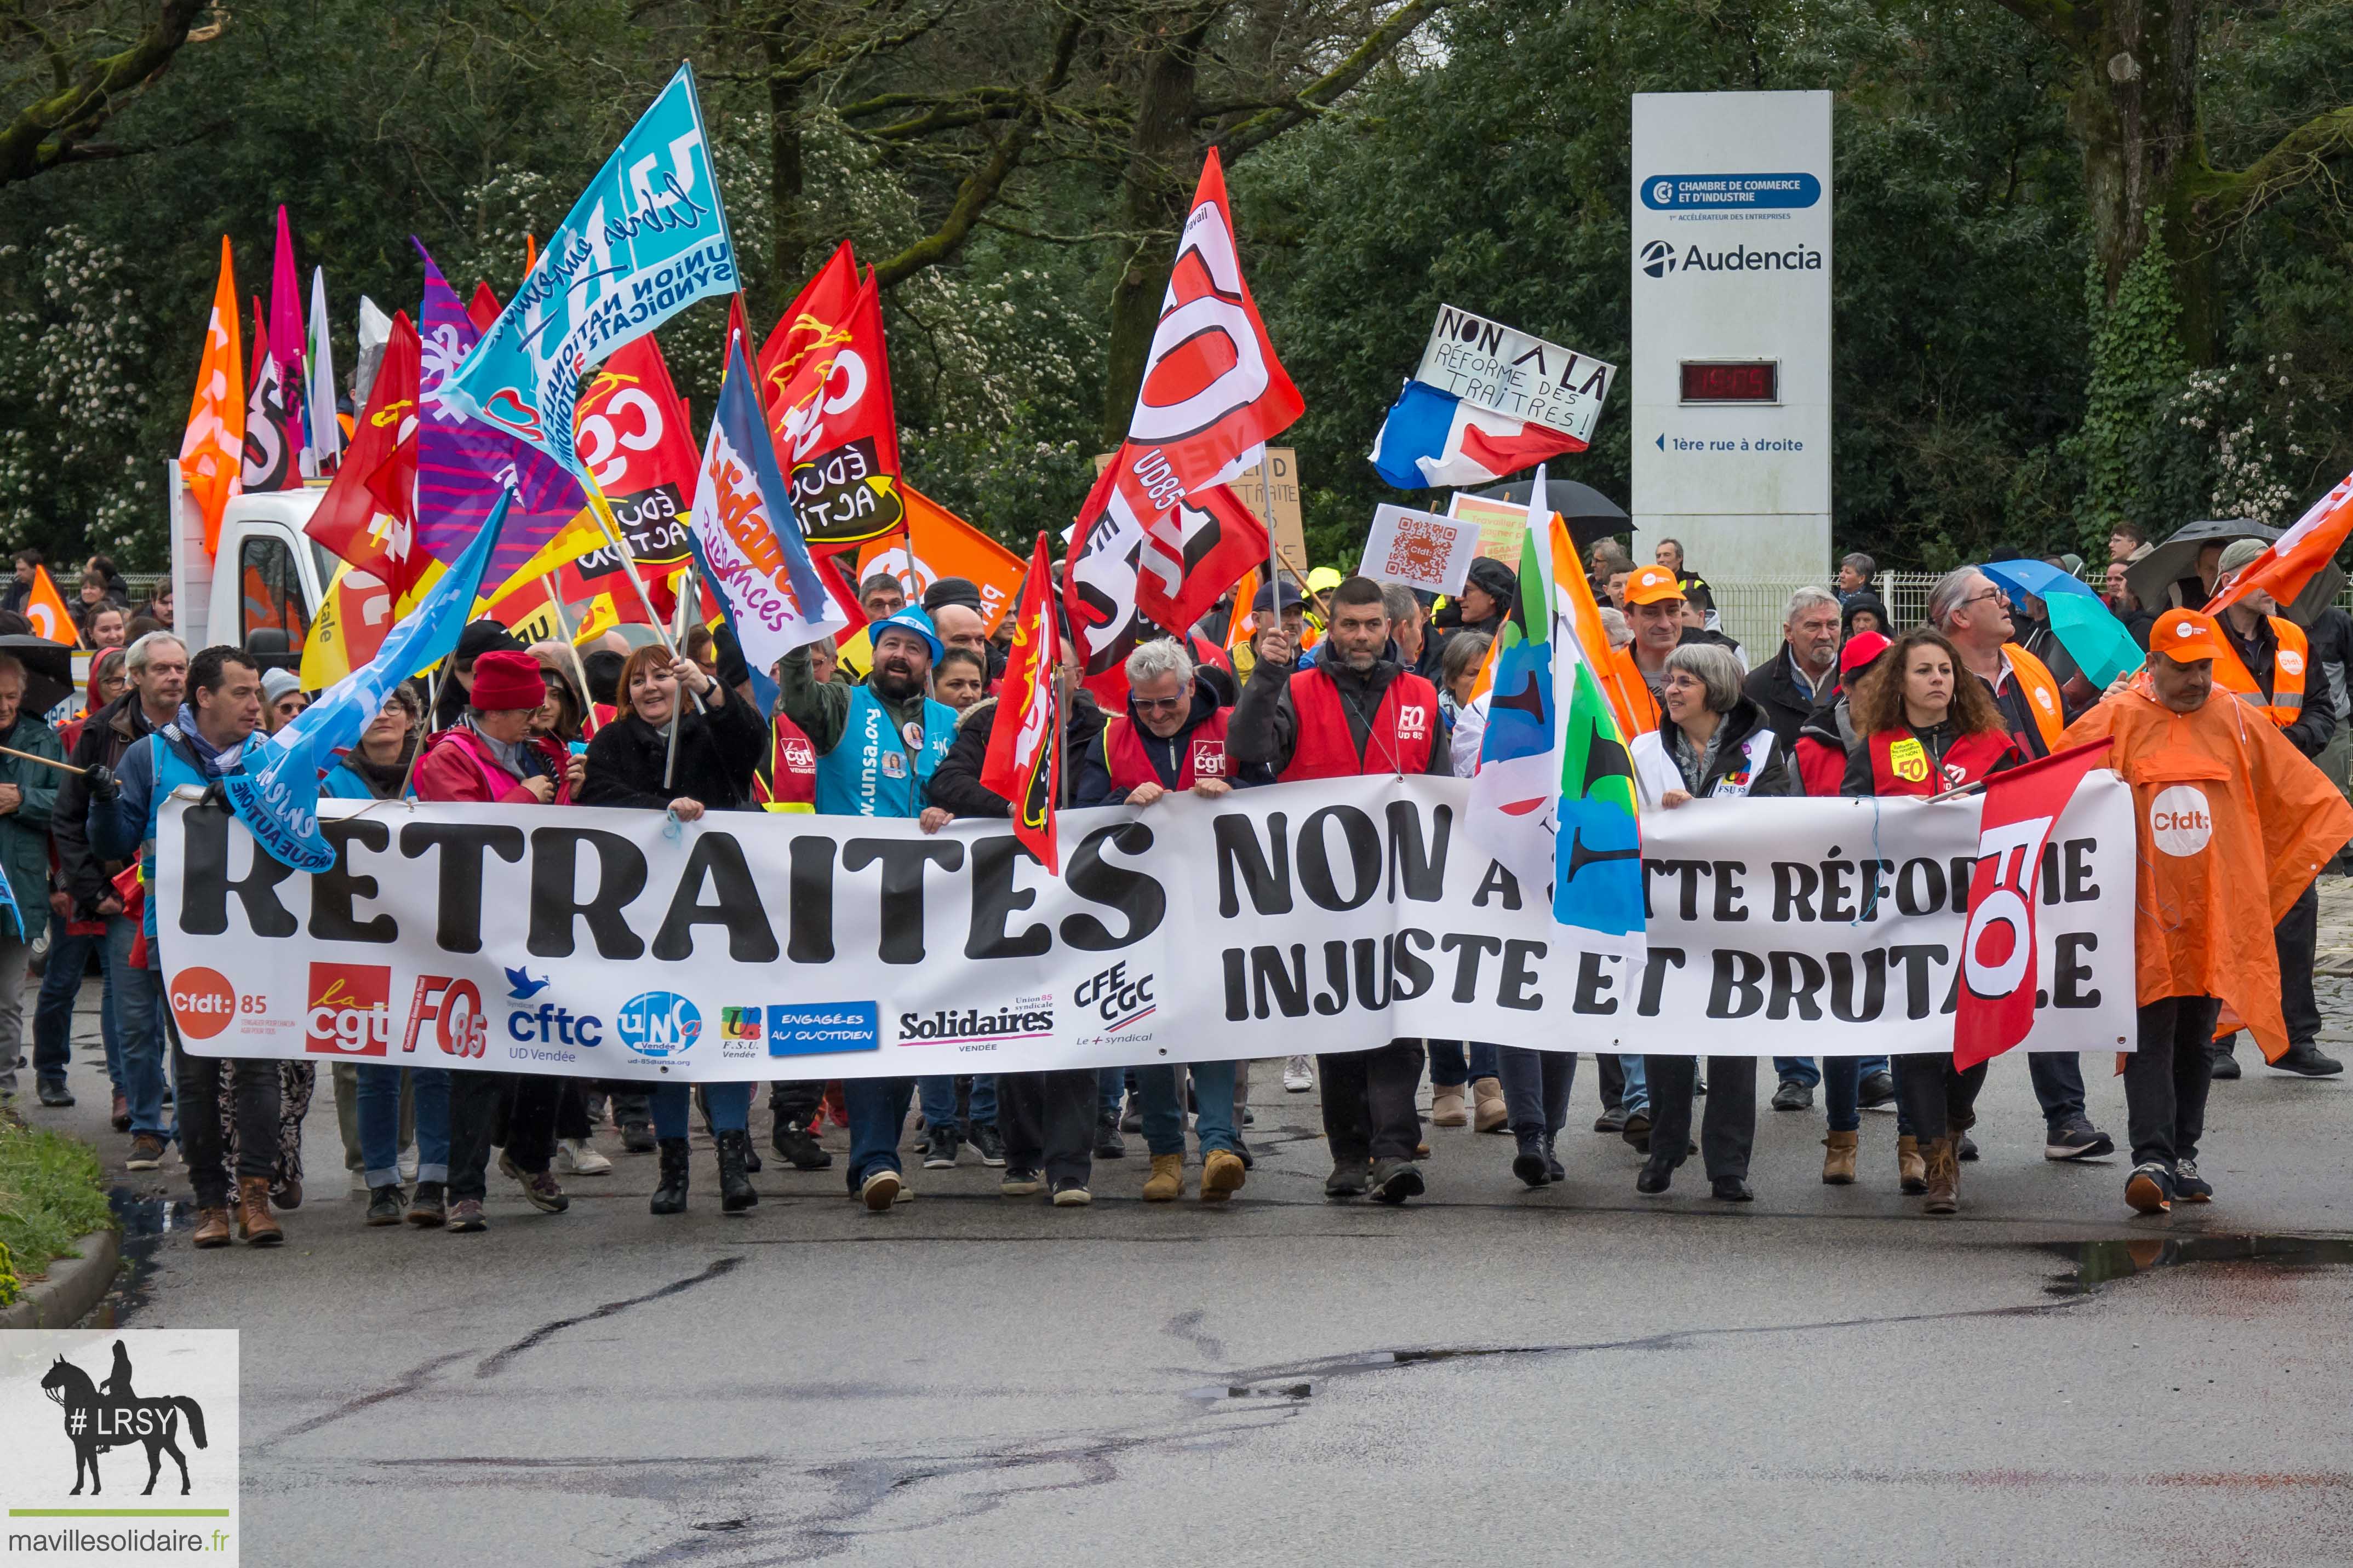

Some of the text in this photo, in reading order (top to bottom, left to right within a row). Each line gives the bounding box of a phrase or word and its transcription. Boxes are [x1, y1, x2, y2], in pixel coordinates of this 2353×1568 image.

[1679, 180, 1800, 191] CHAMBRE DE COMMERCE
[1679, 192, 1755, 202] ET D'INDUSTRIE
[1678, 212, 1728, 221] ACCÉLÉRATEUR
[1681, 243, 1822, 271] Audencia
[1438, 309, 1607, 401] NON A LA
[1434, 343, 1579, 405] RÉFORME DES
[1673, 438, 1803, 451] 1ère rue à droite
[1133, 448, 1186, 510] UD85
[1472, 515, 1516, 528] Travailler
[1412, 731, 1423, 740] 85
[786, 748, 812, 766] cgt
[1195, 754, 1225, 773] cgt
[2155, 811, 2209, 831] Cfdt:
[1213, 800, 1453, 918] NON
[1472, 857, 1522, 910] A
[179, 805, 1167, 965] RETRAITES
[1074, 960, 1126, 1008] CFE
[1222, 928, 1547, 1021] INJUSTE
[1572, 946, 1686, 1018] ET
[173, 992, 267, 1014] Cfdt: 85
[1015, 1002, 1053, 1011] syndicale
[1100, 974, 1153, 1020] CGC
[403, 975, 481, 1055] FO
[508, 1003, 603, 1047] cftc
[782, 1014, 864, 1025] ENGAGÉ-ES
[899, 1007, 1054, 1039] Solidaires
[306, 1002, 389, 1051] cgt
[452, 1012, 488, 1059] 85
[795, 1030, 872, 1041] QUOTIDIEN
[959, 1044, 997, 1052] VENDÉE
[1105, 1033, 1152, 1044] syndical
[509, 1048, 575, 1062] UD Vendée
[628, 1058, 690, 1066] ud-85@unsa.org
